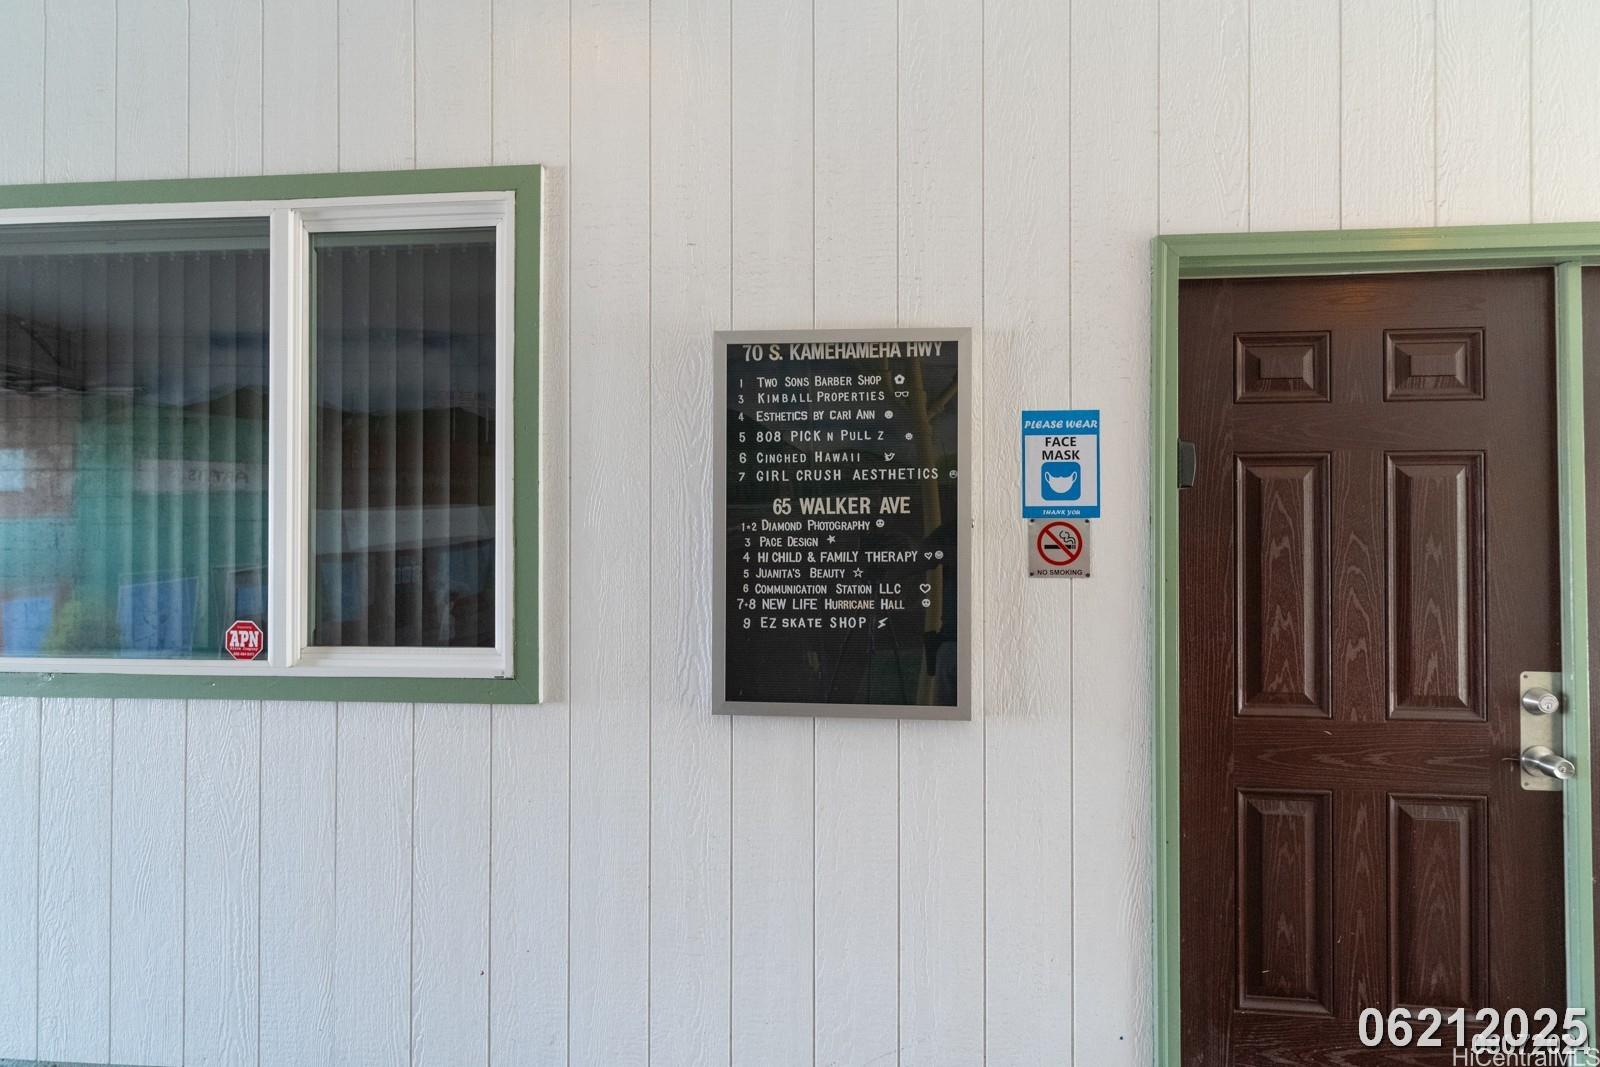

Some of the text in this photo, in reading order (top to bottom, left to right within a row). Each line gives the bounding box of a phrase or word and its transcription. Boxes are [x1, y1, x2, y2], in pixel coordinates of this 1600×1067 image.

[742, 342, 943, 362] 70 S. KAMEHAMEHA HWY
[739, 375, 882, 388] 1 TWO SONS BARBER SHOP
[738, 391, 885, 404] 3 KIMBALL PROPERTIES
[738, 410, 876, 422] 4 ESTHETICS BY CARI ANN
[1024, 420, 1098, 429] PLEASE WEAR
[739, 432, 746, 442] 5
[756, 432, 781, 442] 808
[790, 431, 821, 442] PICK
[840, 430, 872, 441] PULL
[1045, 437, 1076, 446] FACE
[739, 452, 860, 463] 6 CINCHED HAWAII
[1042, 450, 1080, 460] MASK
[739, 468, 939, 482] 7 GIRL CRUSH AESTHETICS
[773, 497, 910, 515] 65 WALKER AVE
[761, 520, 802, 531] DIAMOND
[807, 520, 870, 531] PHOTOGRAPHY
[744, 537, 818, 547] 3 PACE DESIGN
[743, 553, 750, 562] 4
[772, 552, 802, 562] CHILD
[807, 552, 816, 562] &
[820, 552, 858, 562] FAMILY
[865, 551, 918, 562] THERAPY
[743, 568, 845, 578] 5 JUANITA'S BEAUTY
[743, 584, 901, 594] 6 COMMUNICATION STATION LLC
[762, 599, 786, 609] NEW
[792, 599, 817, 609] LIFE
[824, 599, 875, 609] HURRICANE
[880, 599, 904, 609] HALL
[743, 618, 866, 629] 9 EZ SKATE SHOP
[230, 630, 259, 647] APN
